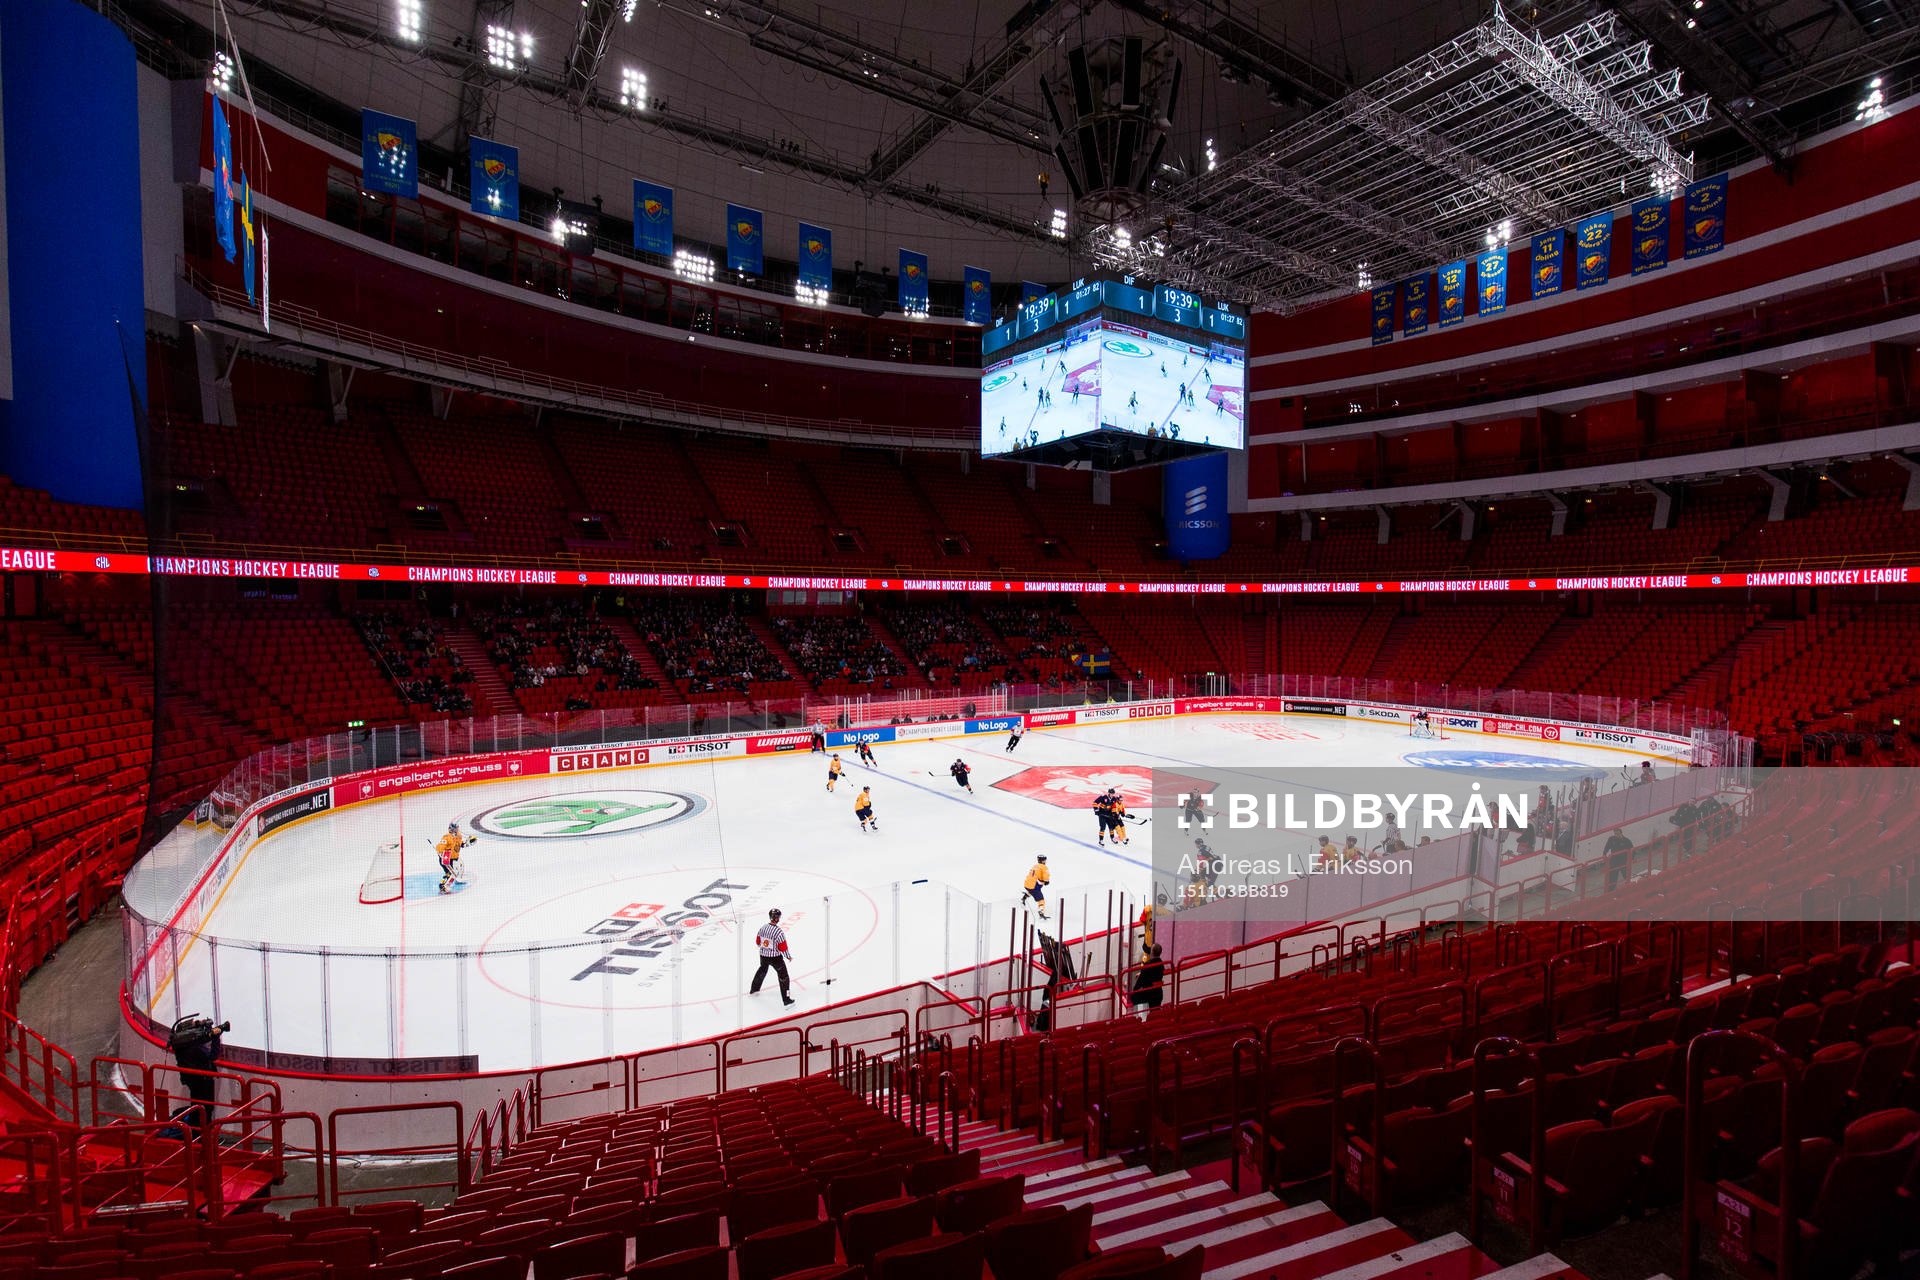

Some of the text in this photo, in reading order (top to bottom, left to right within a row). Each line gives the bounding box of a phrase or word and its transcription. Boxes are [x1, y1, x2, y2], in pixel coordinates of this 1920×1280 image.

[1701, 192, 1710, 203] 2
[1642, 212, 1659, 224] 25
[1586, 229, 1602, 242] 22
[1542, 243, 1553, 254] 11
[1485, 261, 1499, 272] 27
[1072, 278, 1084, 291] LUK
[1124, 275, 1136, 286] DIF
[1446, 274, 1457, 284] 12
[1076, 283, 1100, 300] 01:27 82
[1139, 295, 1144, 310] 1
[1164, 289, 1193, 309] 19:39
[1025, 298, 1049, 320] 19:39
[1064, 300, 1069, 314] 1
[1217, 301, 1229, 312] LUK
[1174, 308, 1181, 323] 3
[1209, 314, 1214, 328] 1
[1220, 312, 1243, 326] 01:27 82
[1033, 318, 1039, 333] 3
[1006, 328, 1010, 341] 1
[146, 557, 340, 577] CHAMPIONS HOCKEY LEAGUE
[408, 567, 557, 583] CHAMPIONS HOCKEY LEAGUE
[608, 572, 726, 586] CHAMPIONS HOCKEY LEAGUE
[1746, 568, 1908, 585] CHAMPIONS HOCKEY LEAGUE
[768, 577, 867, 588] CHAMPIONS HOCKEY LEAGUE
[903, 580, 992, 590] CHAMPIONS HOCKEY LEAGUE
[1024, 582, 1107, 591] CHAMPIONS HOCKEY LEAGUE
[1138, 583, 1226, 592] CHAMPIONS HOCKEY LEAGUE
[1262, 582, 1360, 592] CHAMPIONS HOCKEY LEAGUE
[1399, 579, 1510, 590] CHAMPIONS HOCKEY LEAGUE
[1556, 575, 1688, 589] CHAMPIONS HOCKEY LEAGUE
[1031, 713, 1069, 723] WARRIOR
[1095, 709, 1120, 718] TISSOT
[1130, 706, 1171, 717] CRAMO
[978, 721, 1008, 731] No Logo
[757, 735, 812, 748] WARRIOR
[843, 732, 880, 744] No Logo
[1593, 732, 1636, 744] TISSOT
[687, 741, 731, 753] TISSOT
[561, 752, 646, 769] CRAMO
[379, 763, 502, 788] engelbert strauss
[418, 777, 463, 788] workwear
[310, 793, 328, 811] .NET
[570, 878, 749, 981] TISSOT
[1724, 1216, 1743, 1239] 12
